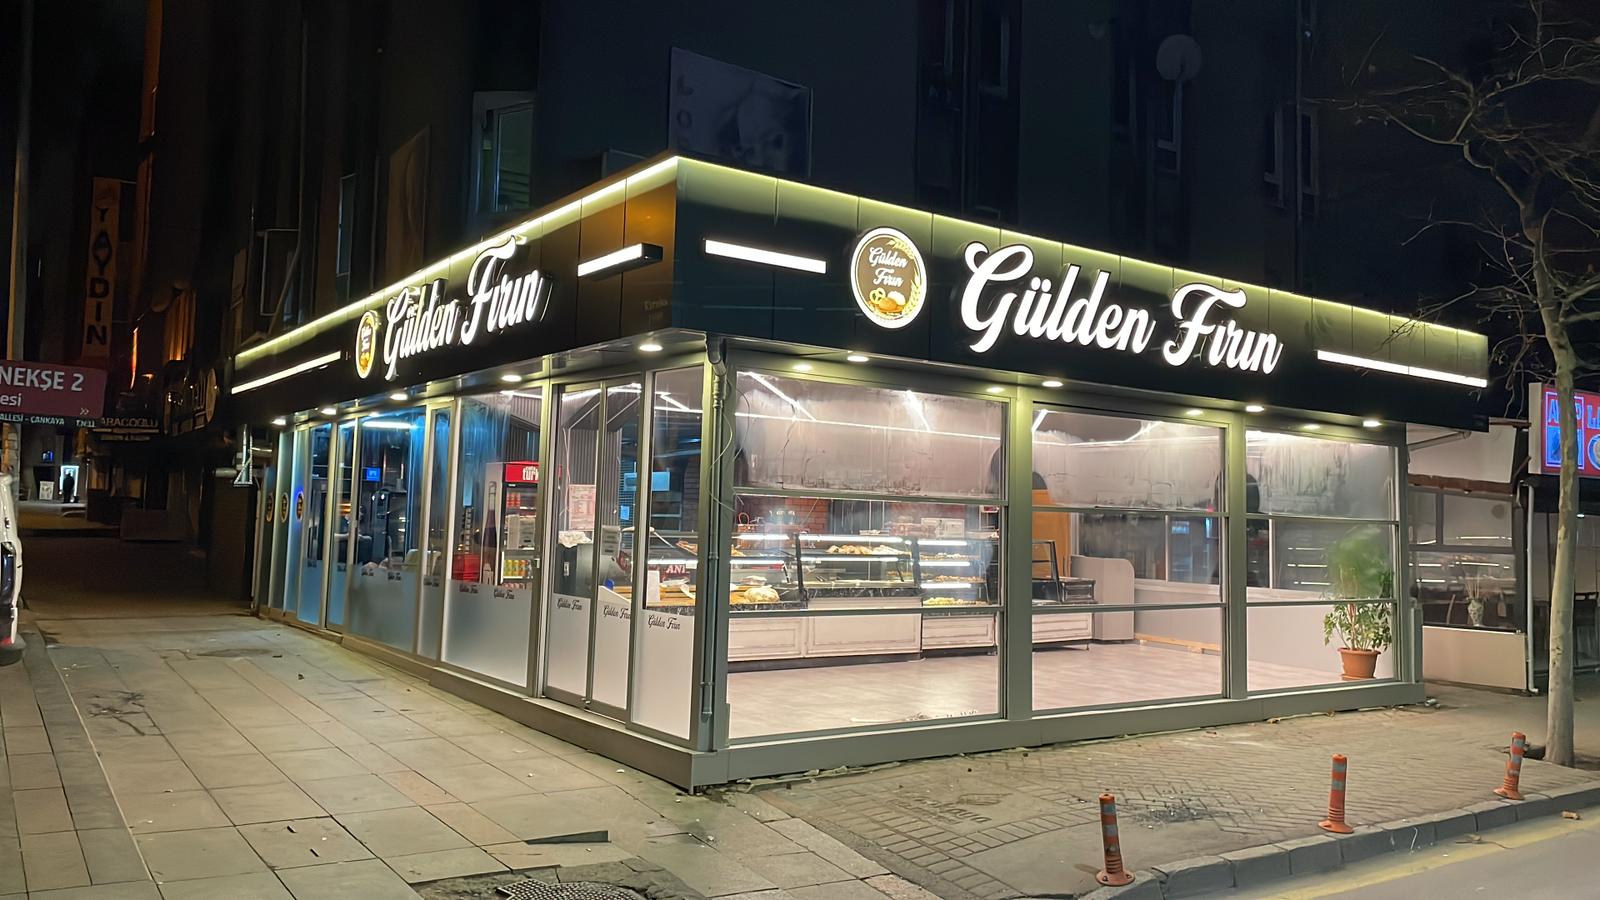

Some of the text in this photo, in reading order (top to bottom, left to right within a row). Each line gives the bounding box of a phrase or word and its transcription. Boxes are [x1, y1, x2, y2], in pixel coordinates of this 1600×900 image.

[868, 246, 909, 268] Gülden
[960, 241, 1284, 374] Gülden Fırın
[384, 281, 460, 380] Gülden
[0, 366, 84, 392] NEKŞE 2
[0, 393, 22, 407] esi
